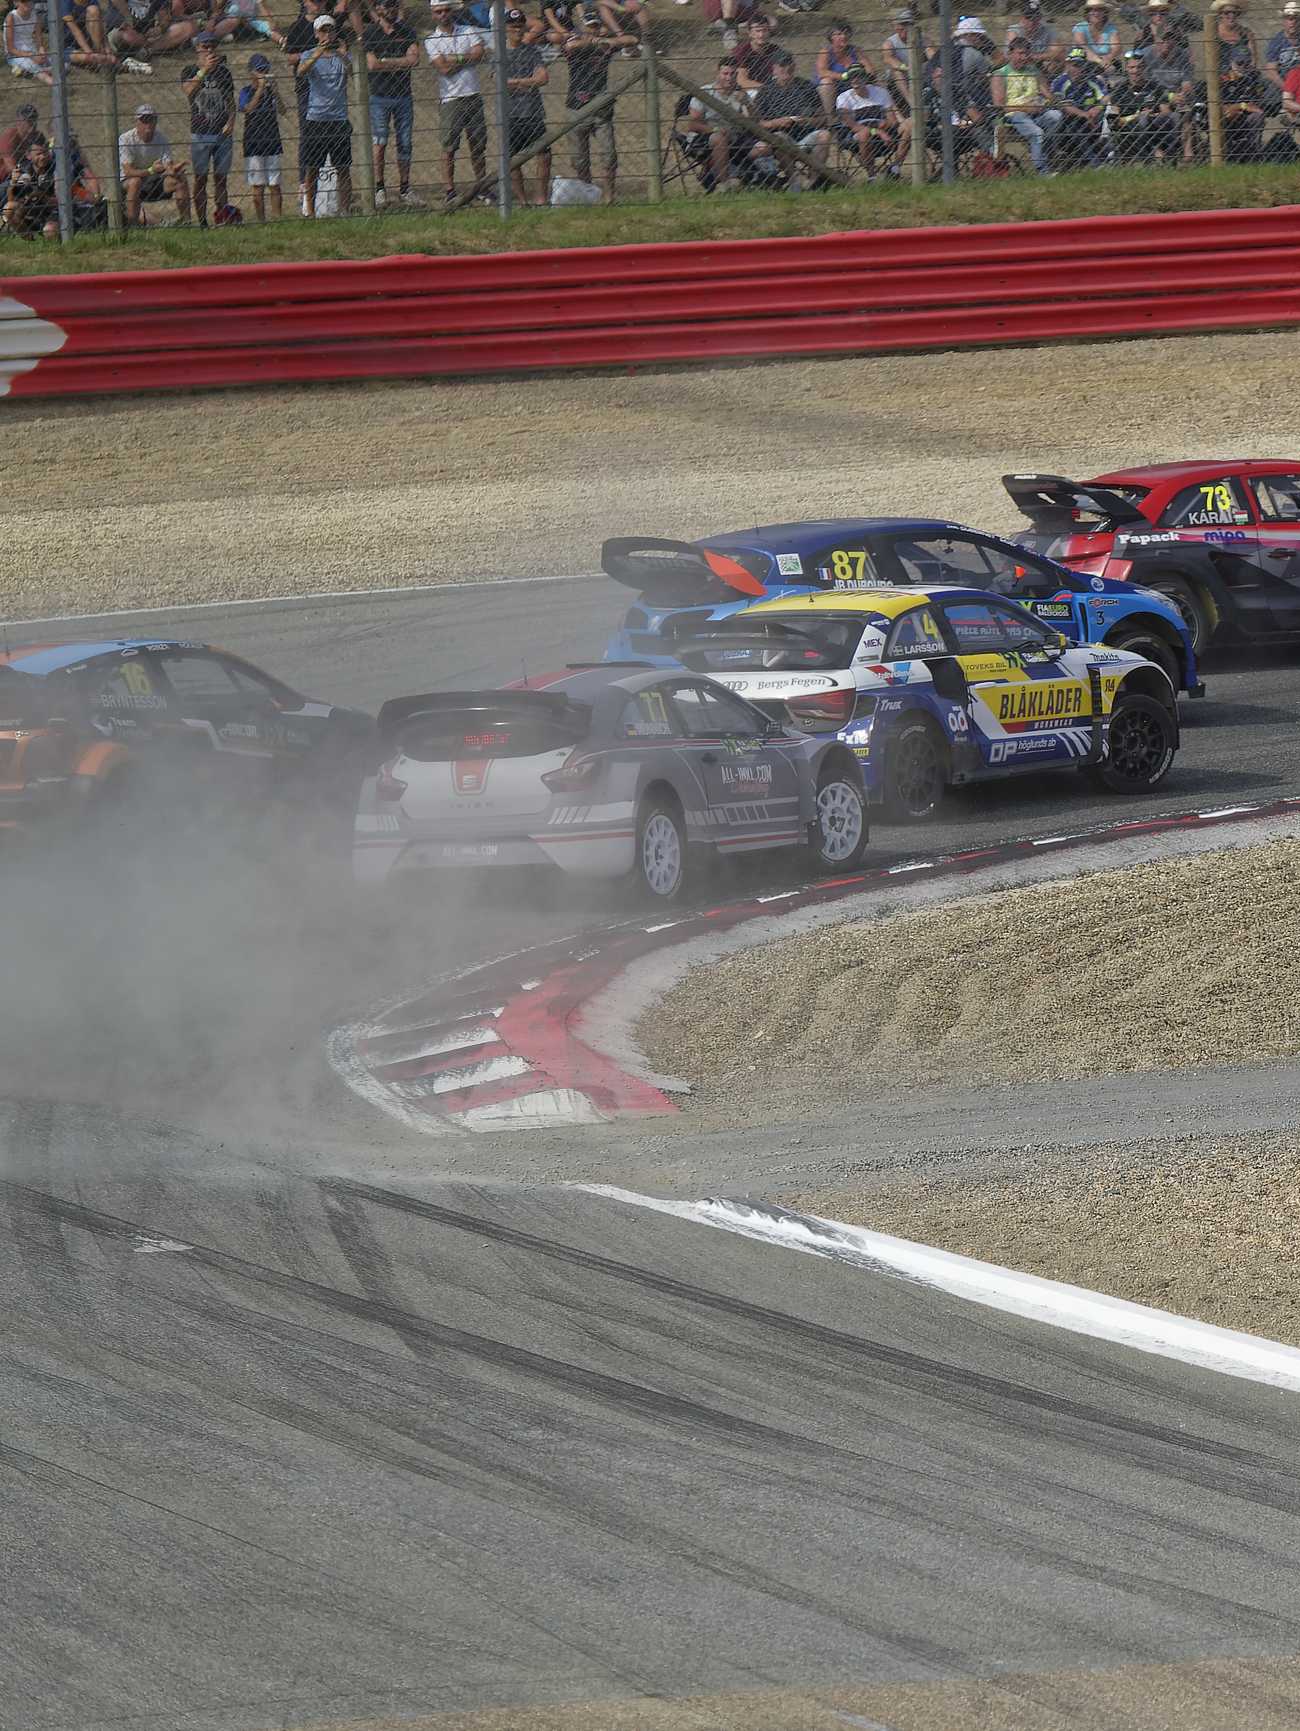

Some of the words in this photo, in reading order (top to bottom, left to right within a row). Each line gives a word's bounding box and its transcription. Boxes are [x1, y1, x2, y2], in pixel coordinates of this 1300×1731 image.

[1200, 485, 1231, 511] 73
[1188, 509, 1233, 525] KÁRAI
[1118, 531, 1180, 545] Papack
[832, 550, 866, 580] 87
[923, 613, 940, 641] 4
[1096, 610, 1105, 626] 3
[904, 643, 945, 655] LARSSON
[120, 662, 152, 695] 16
[757, 680, 790, 690] Bergs
[791, 677, 826, 688] Fegen
[100, 694, 168, 709] BRYNTESSON
[639, 692, 668, 722] 77
[999, 684, 1082, 720] BLÅKLÄDER
